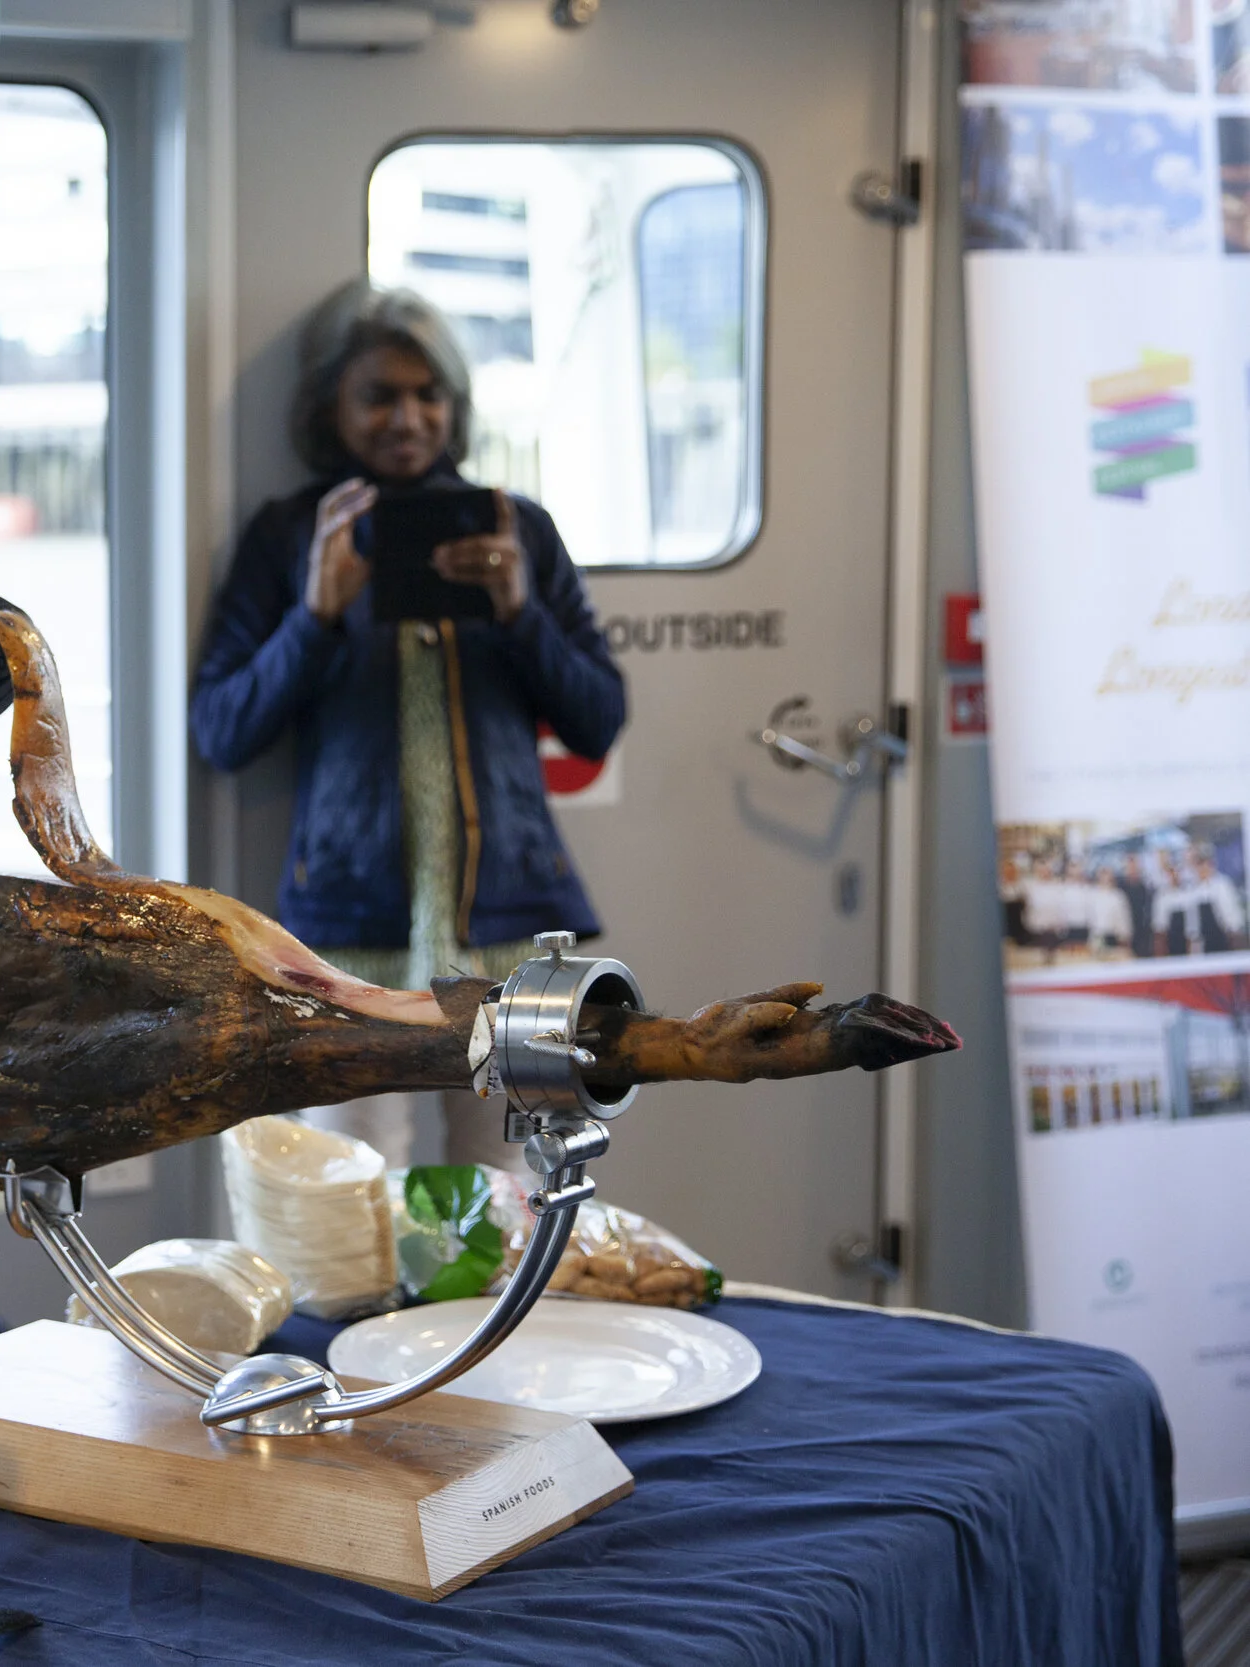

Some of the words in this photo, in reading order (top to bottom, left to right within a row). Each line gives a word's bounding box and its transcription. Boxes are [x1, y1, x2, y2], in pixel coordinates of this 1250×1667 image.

[605, 610, 787, 652] OUTSIDE
[482, 1493, 523, 1521] SPANISH
[524, 1476, 555, 1499] FOODS
